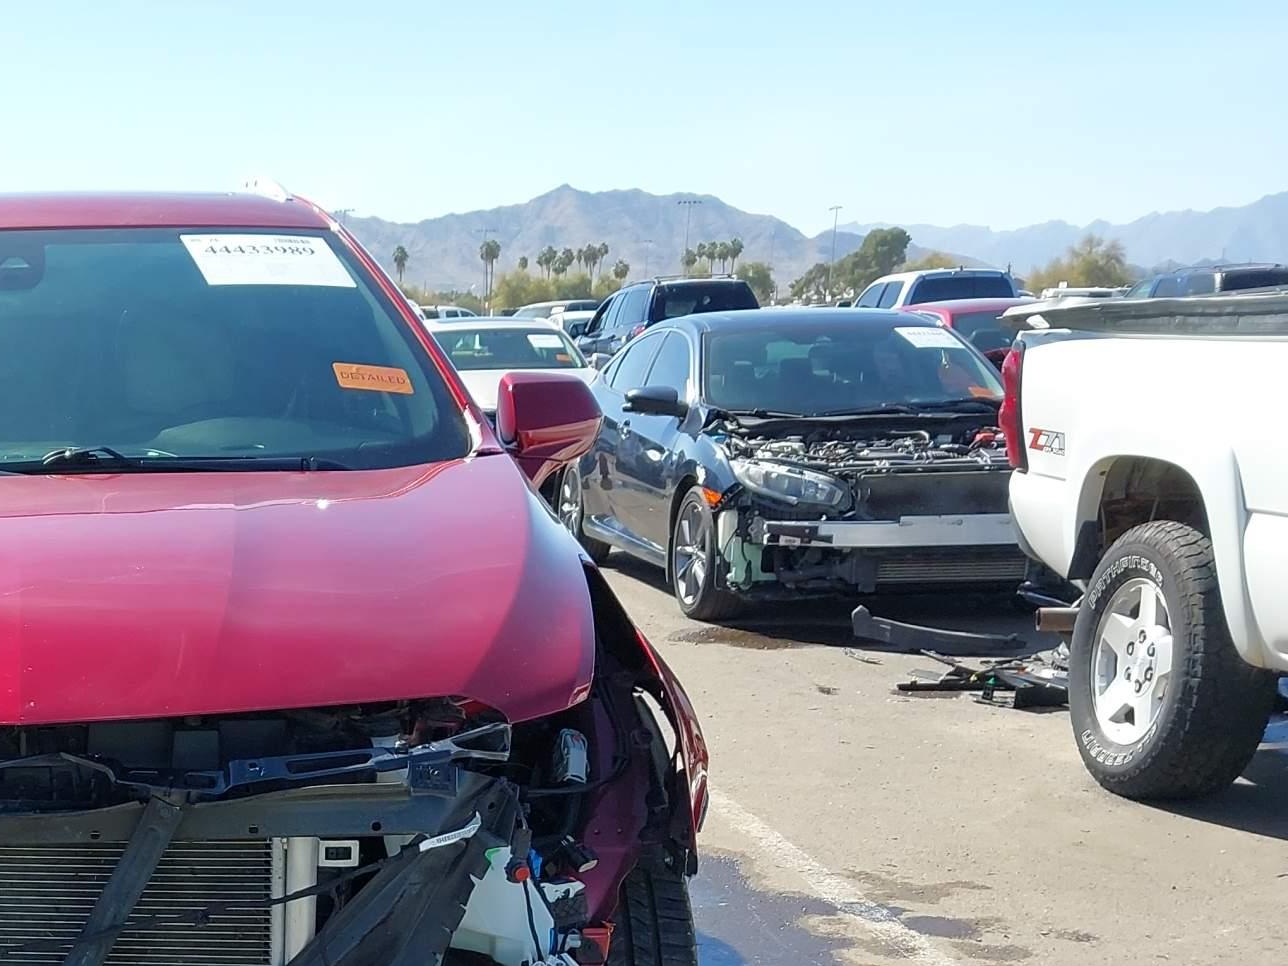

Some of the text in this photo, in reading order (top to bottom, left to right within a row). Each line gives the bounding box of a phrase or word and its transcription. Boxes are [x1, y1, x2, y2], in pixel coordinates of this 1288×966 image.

[204, 244, 316, 256] 44433989
[339, 370, 406, 385] DETAILED
[1028, 427, 1066, 451] Z71
